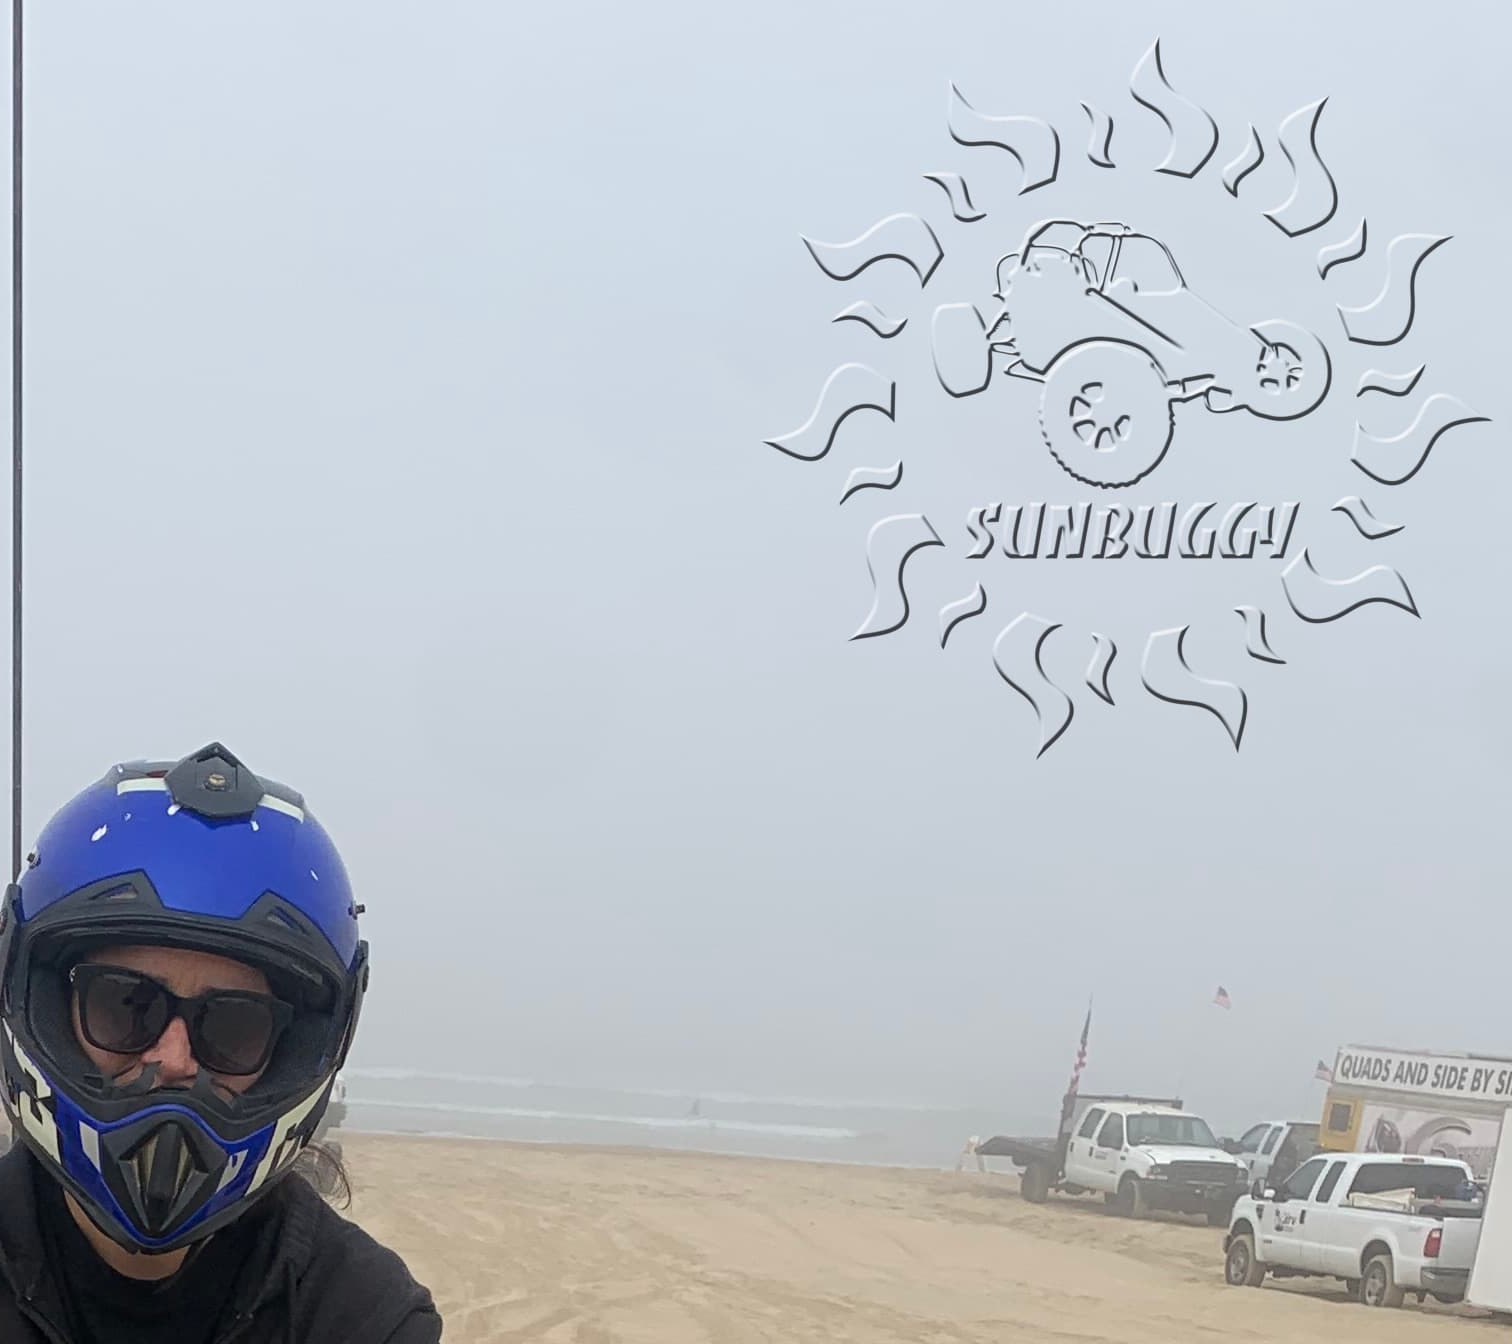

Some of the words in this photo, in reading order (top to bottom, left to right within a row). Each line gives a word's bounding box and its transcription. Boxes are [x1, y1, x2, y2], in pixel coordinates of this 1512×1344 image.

[1340, 1054, 1392, 1082] QUADS
[1392, 1060, 1429, 1086] AND
[1431, 1064, 1469, 1091] SIDE
[1470, 1068, 1495, 1094] BY
[1495, 1069, 1512, 1096] SI
